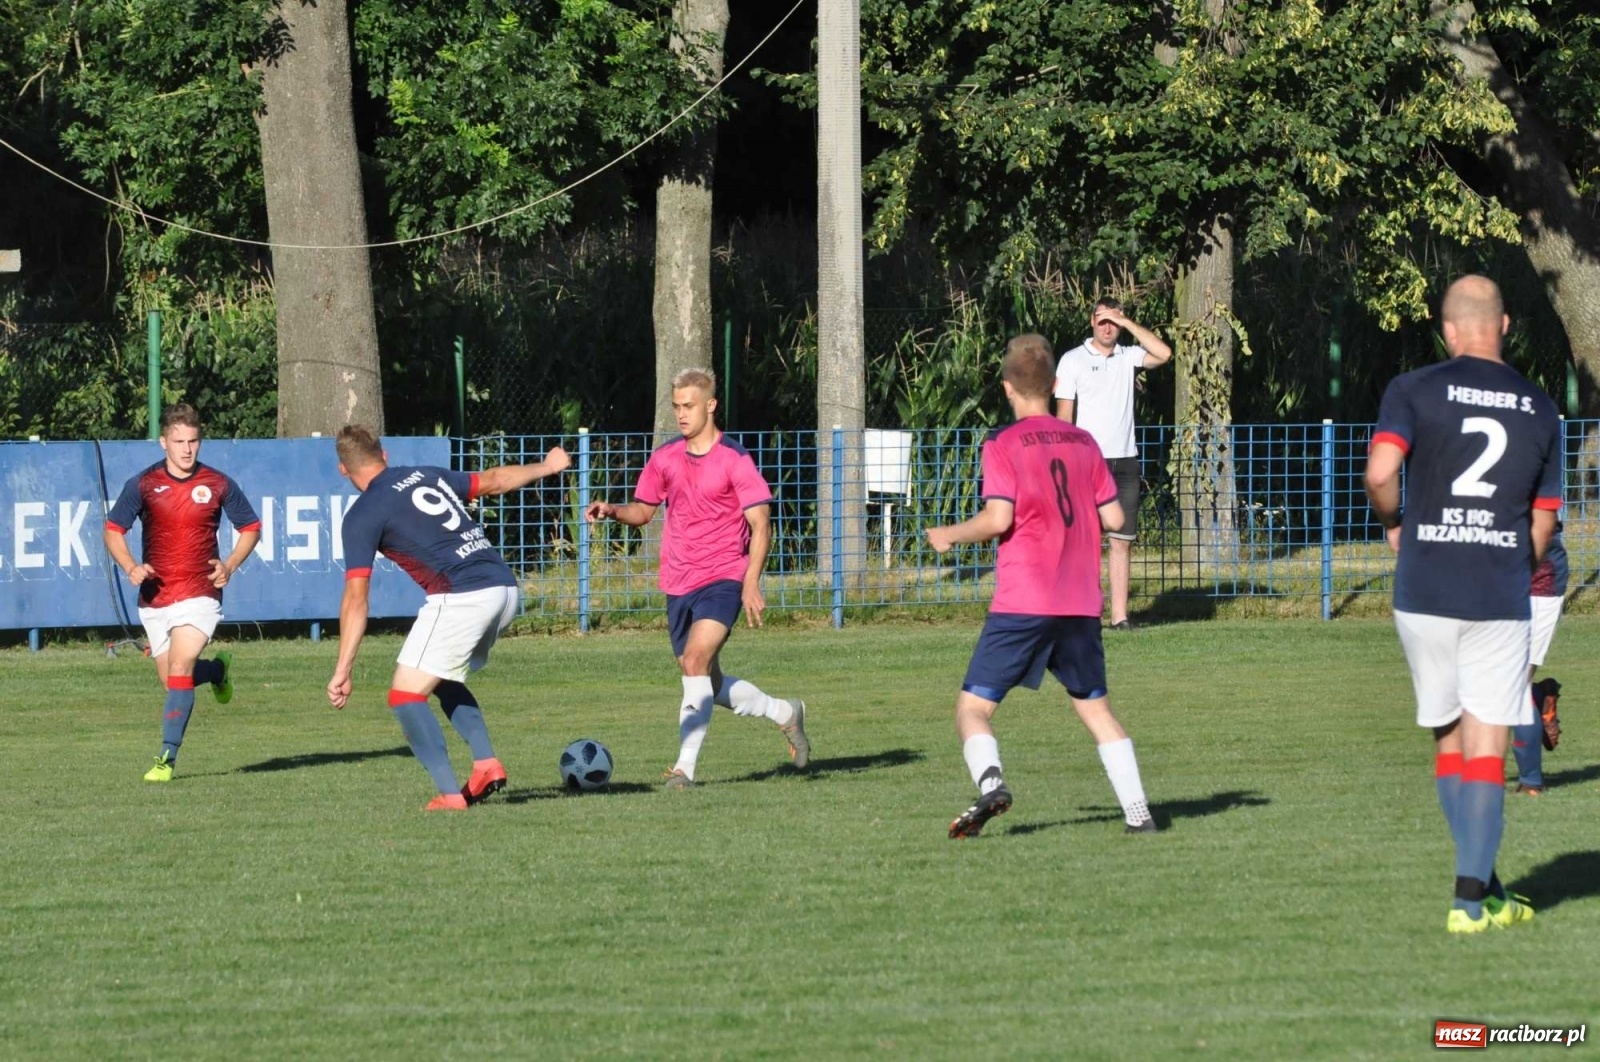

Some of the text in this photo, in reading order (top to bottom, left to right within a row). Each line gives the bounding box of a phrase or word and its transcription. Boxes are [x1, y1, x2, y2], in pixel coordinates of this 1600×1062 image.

[1447, 385, 1518, 409] HERBER
[1451, 416, 1508, 499] 2
[391, 470, 426, 492] JASNY
[1050, 458, 1074, 528] 8
[1442, 507, 1464, 525] KS
